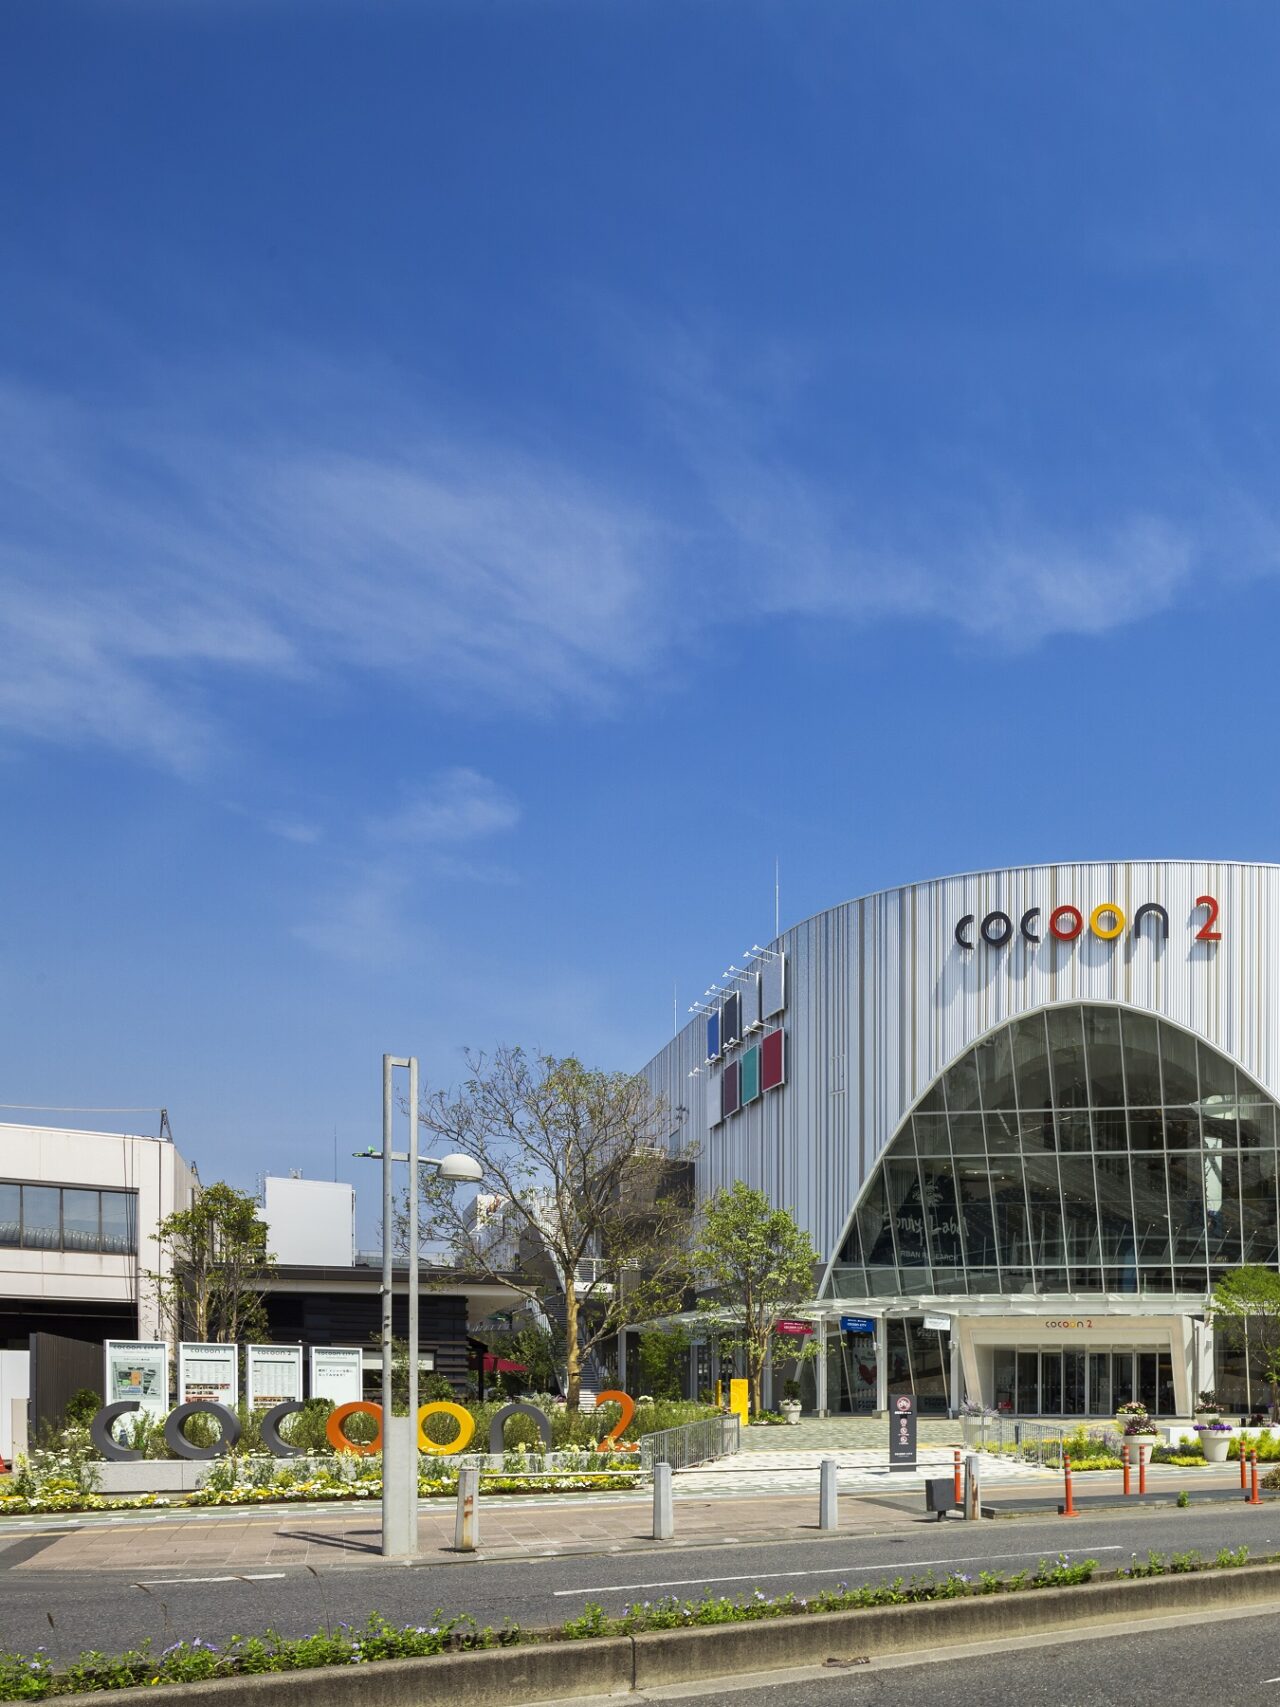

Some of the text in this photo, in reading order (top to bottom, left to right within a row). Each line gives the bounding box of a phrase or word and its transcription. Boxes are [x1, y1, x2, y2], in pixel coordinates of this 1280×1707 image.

[955, 895, 1222, 949] cocoon 2
[1086, 1319, 1093, 1329] 2
[595, 1390, 637, 1452] 2
